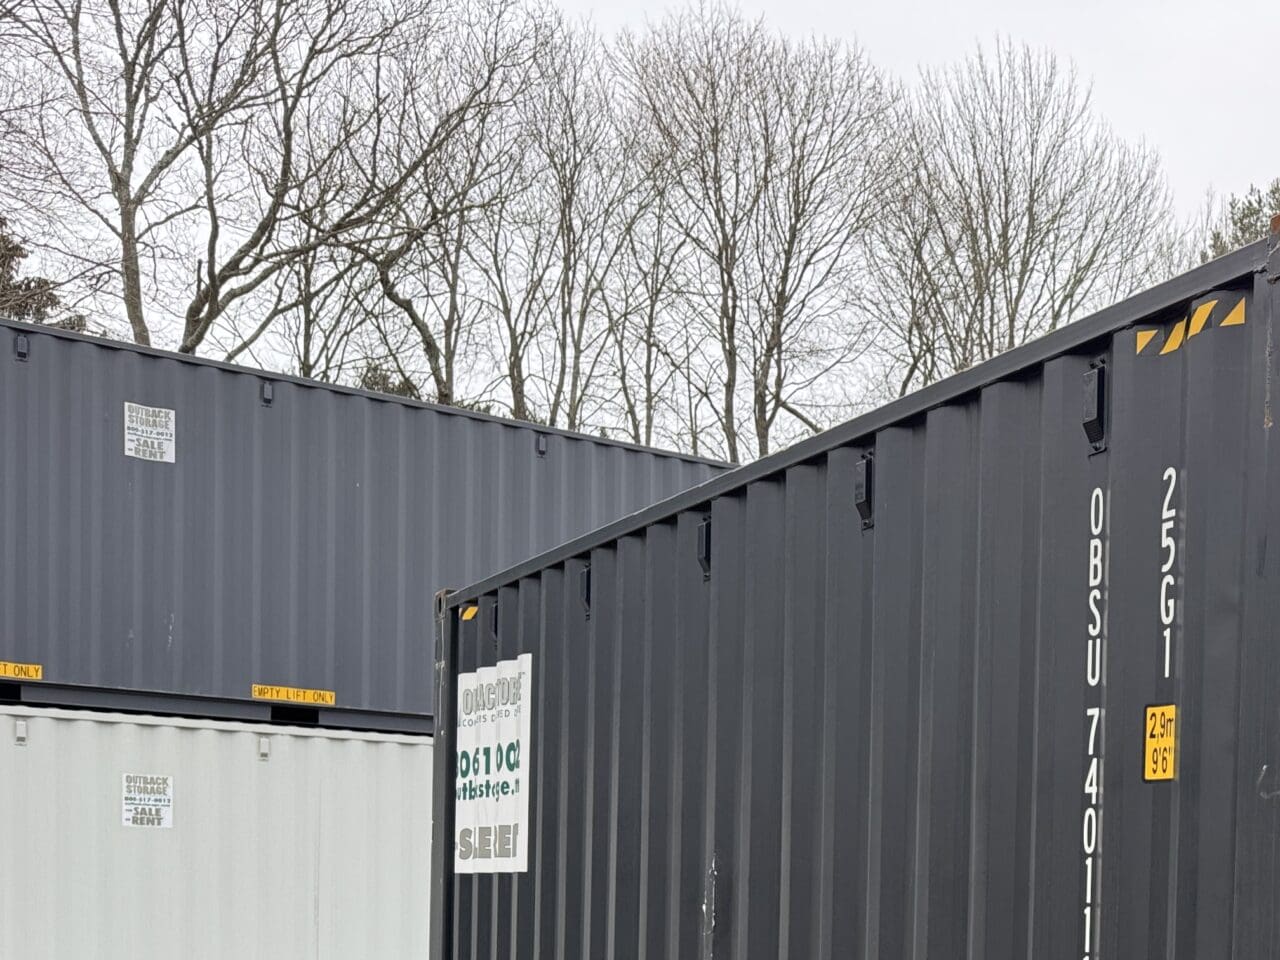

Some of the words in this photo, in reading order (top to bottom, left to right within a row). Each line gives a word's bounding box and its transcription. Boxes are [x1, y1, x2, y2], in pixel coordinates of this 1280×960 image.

[136, 438, 164, 450] SALE
[134, 447, 166, 460] RENT
[1160, 466, 1177, 678] 25G1
[13, 664, 40, 678] ONLY
[253, 685, 281, 699] EMPTY
[286, 689, 307, 701] LIFT
[312, 692, 334, 704] ONLY
[126, 775, 169, 786] OUTBACK
[126, 784, 168, 796] STORAGE
[133, 807, 162, 816] SALE
[132, 816, 164, 826] RENT
